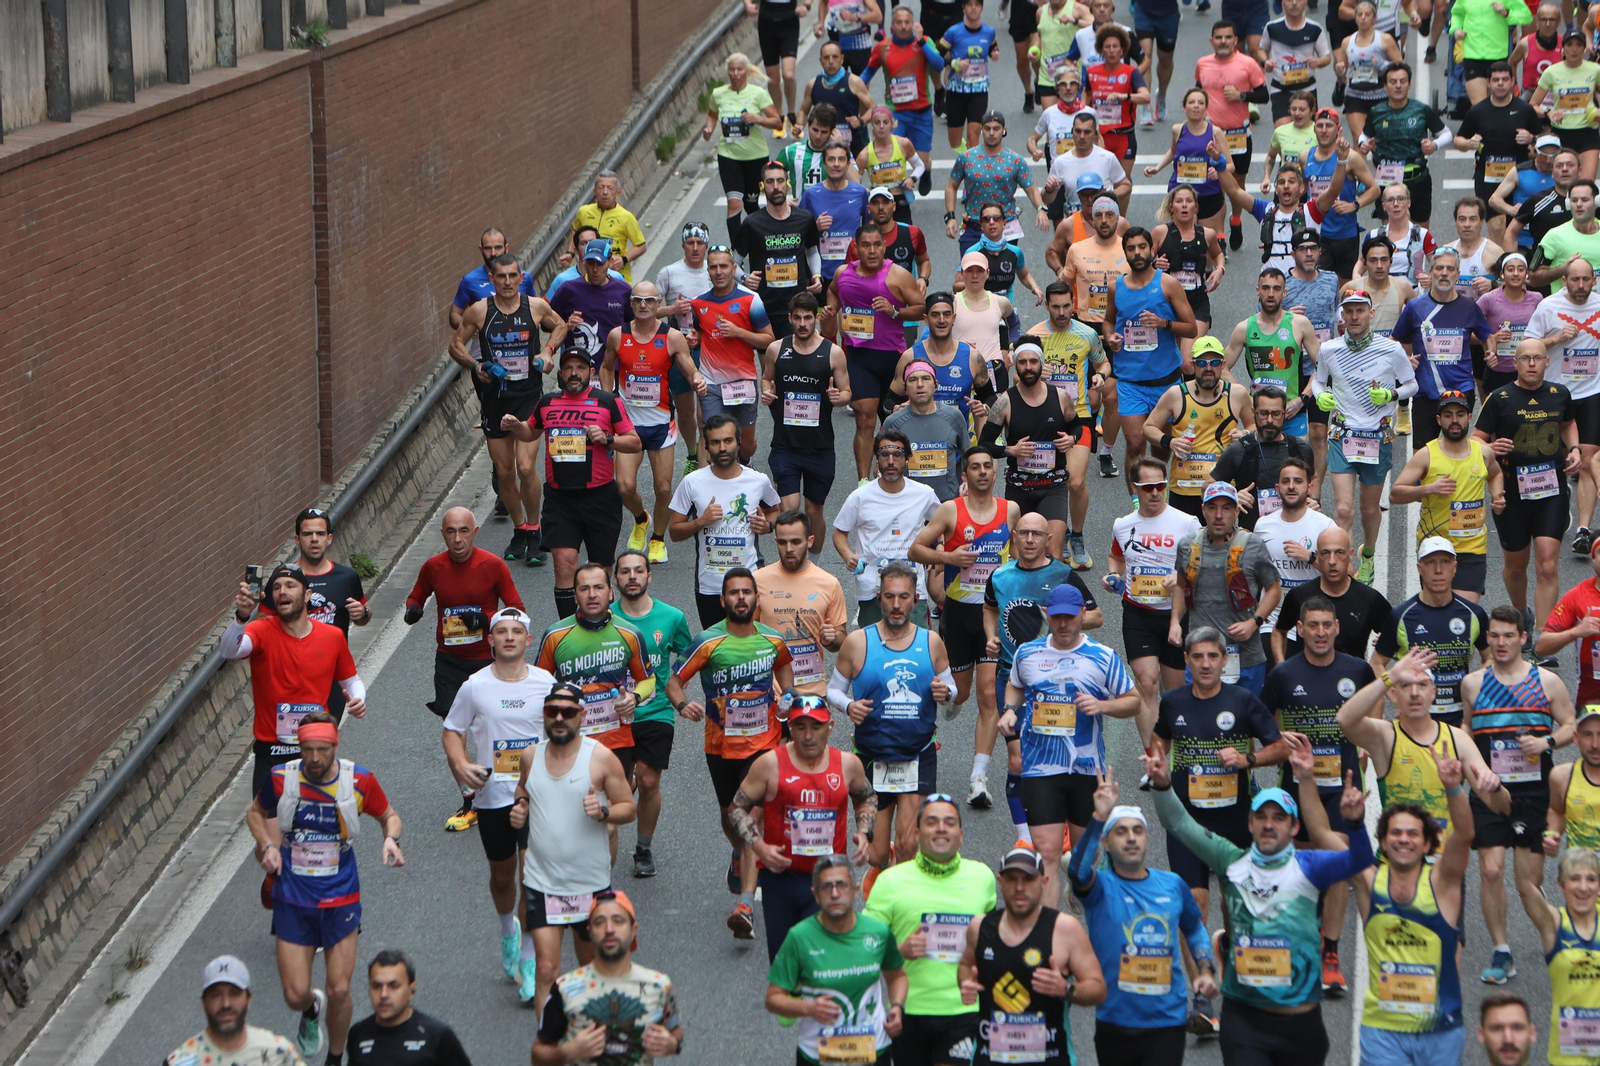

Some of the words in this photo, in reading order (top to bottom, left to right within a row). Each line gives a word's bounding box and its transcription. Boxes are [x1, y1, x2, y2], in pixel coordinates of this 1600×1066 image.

[765, 237, 801, 246] CHICAGO
[783, 375, 819, 385] CAPACITY
[1262, 377, 1284, 385] ZURICH
[546, 410, 600, 421] EMC
[794, 645, 816, 653] ZURICH
[575, 646, 625, 673] MOJAMAS
[1438, 674, 1462, 682] ZURICH
[1437, 687, 1453, 695] 2770
[586, 692, 611, 702] ZURICH
[1046, 694, 1072, 703] ZURICH
[742, 698, 764, 707] ZURICH
[293, 705, 319, 713] ZURICH
[588, 706, 605, 715] 7485
[1045, 708, 1061, 716] 5300
[741, 711, 756, 719] 7461
[586, 716, 610, 725] ALFONSO
[1205, 766, 1233, 774] ZURICH
[807, 812, 830, 820] ZURICH
[940, 915, 970, 924] ZURICH
[1253, 939, 1284, 947] ZURICH
[1140, 947, 1170, 956] ZURICH
[1398, 966, 1430, 975] ZURICH
[1008, 1014, 1040, 1024] ZURICH
[837, 1026, 869, 1034] ZURICH
